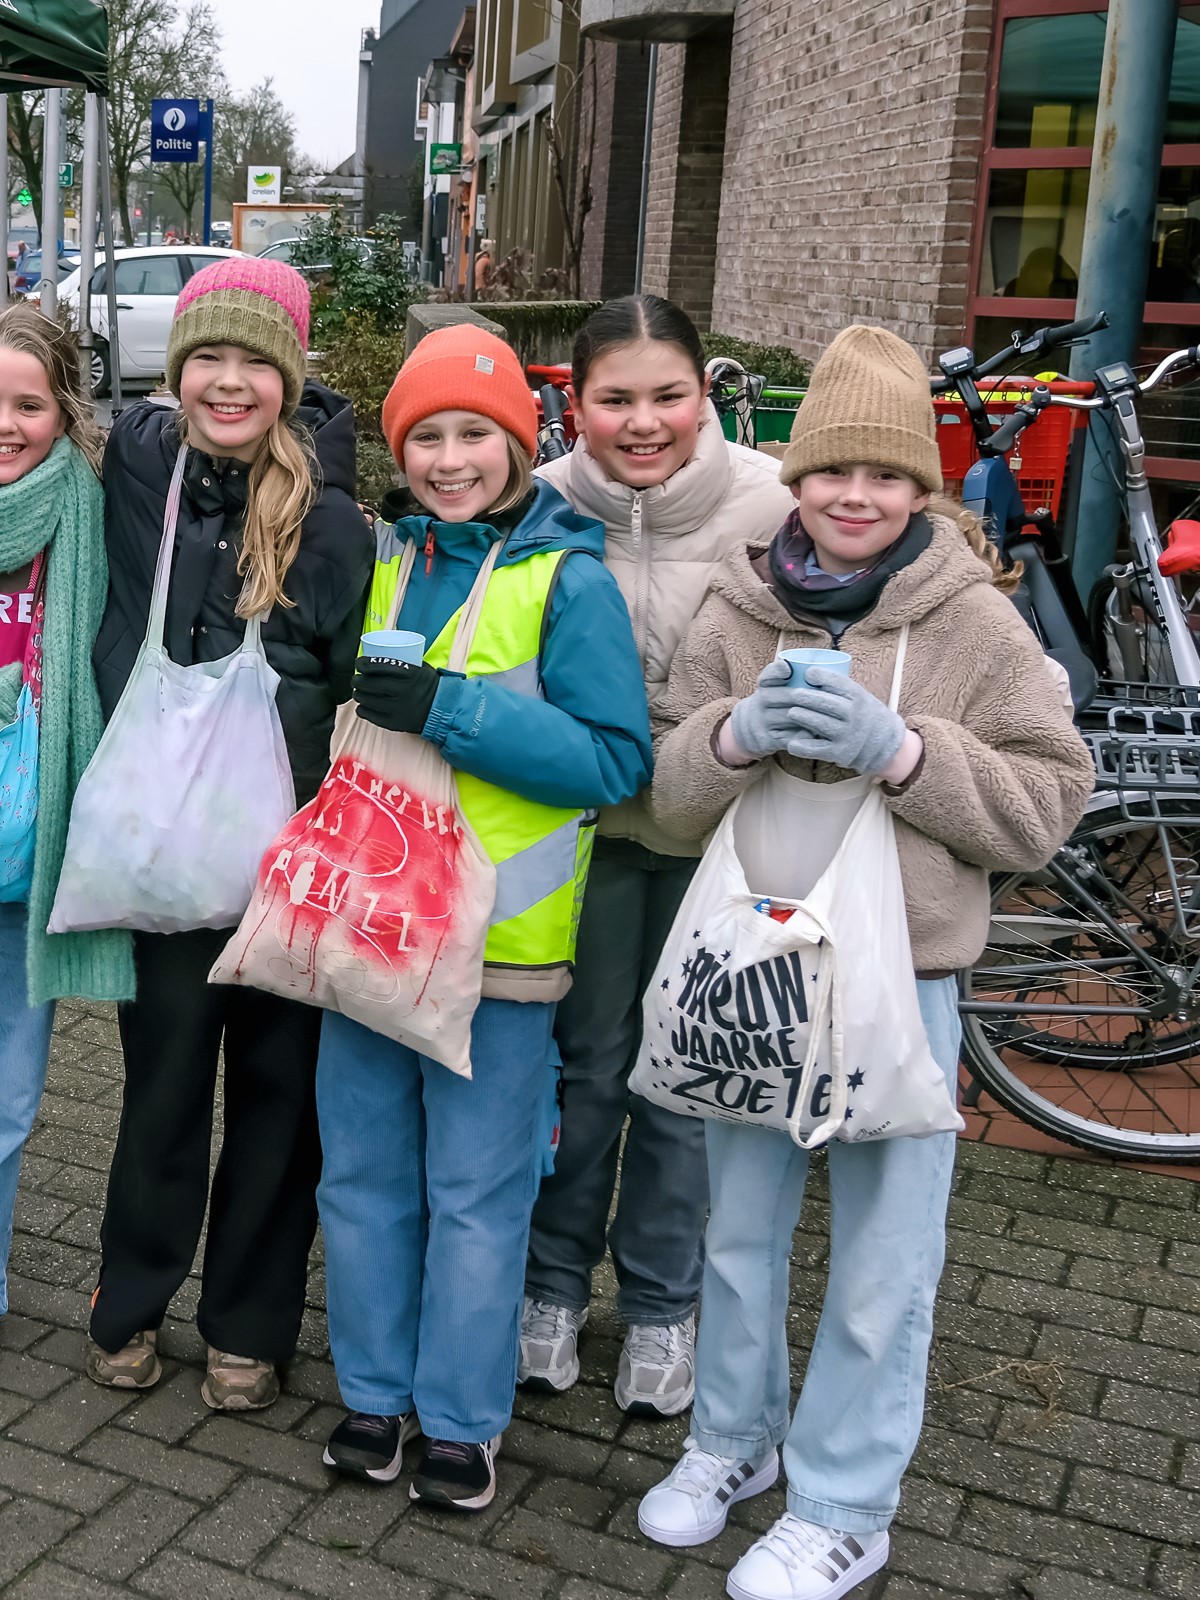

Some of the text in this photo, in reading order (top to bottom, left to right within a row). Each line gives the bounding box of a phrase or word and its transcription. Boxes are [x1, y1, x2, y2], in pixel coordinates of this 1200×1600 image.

[156, 138, 192, 149] Politie
[370, 657, 410, 670] KIPSTA
[671, 1015, 802, 1070] JAARKE
[670, 1060, 833, 1119] ZOETE
